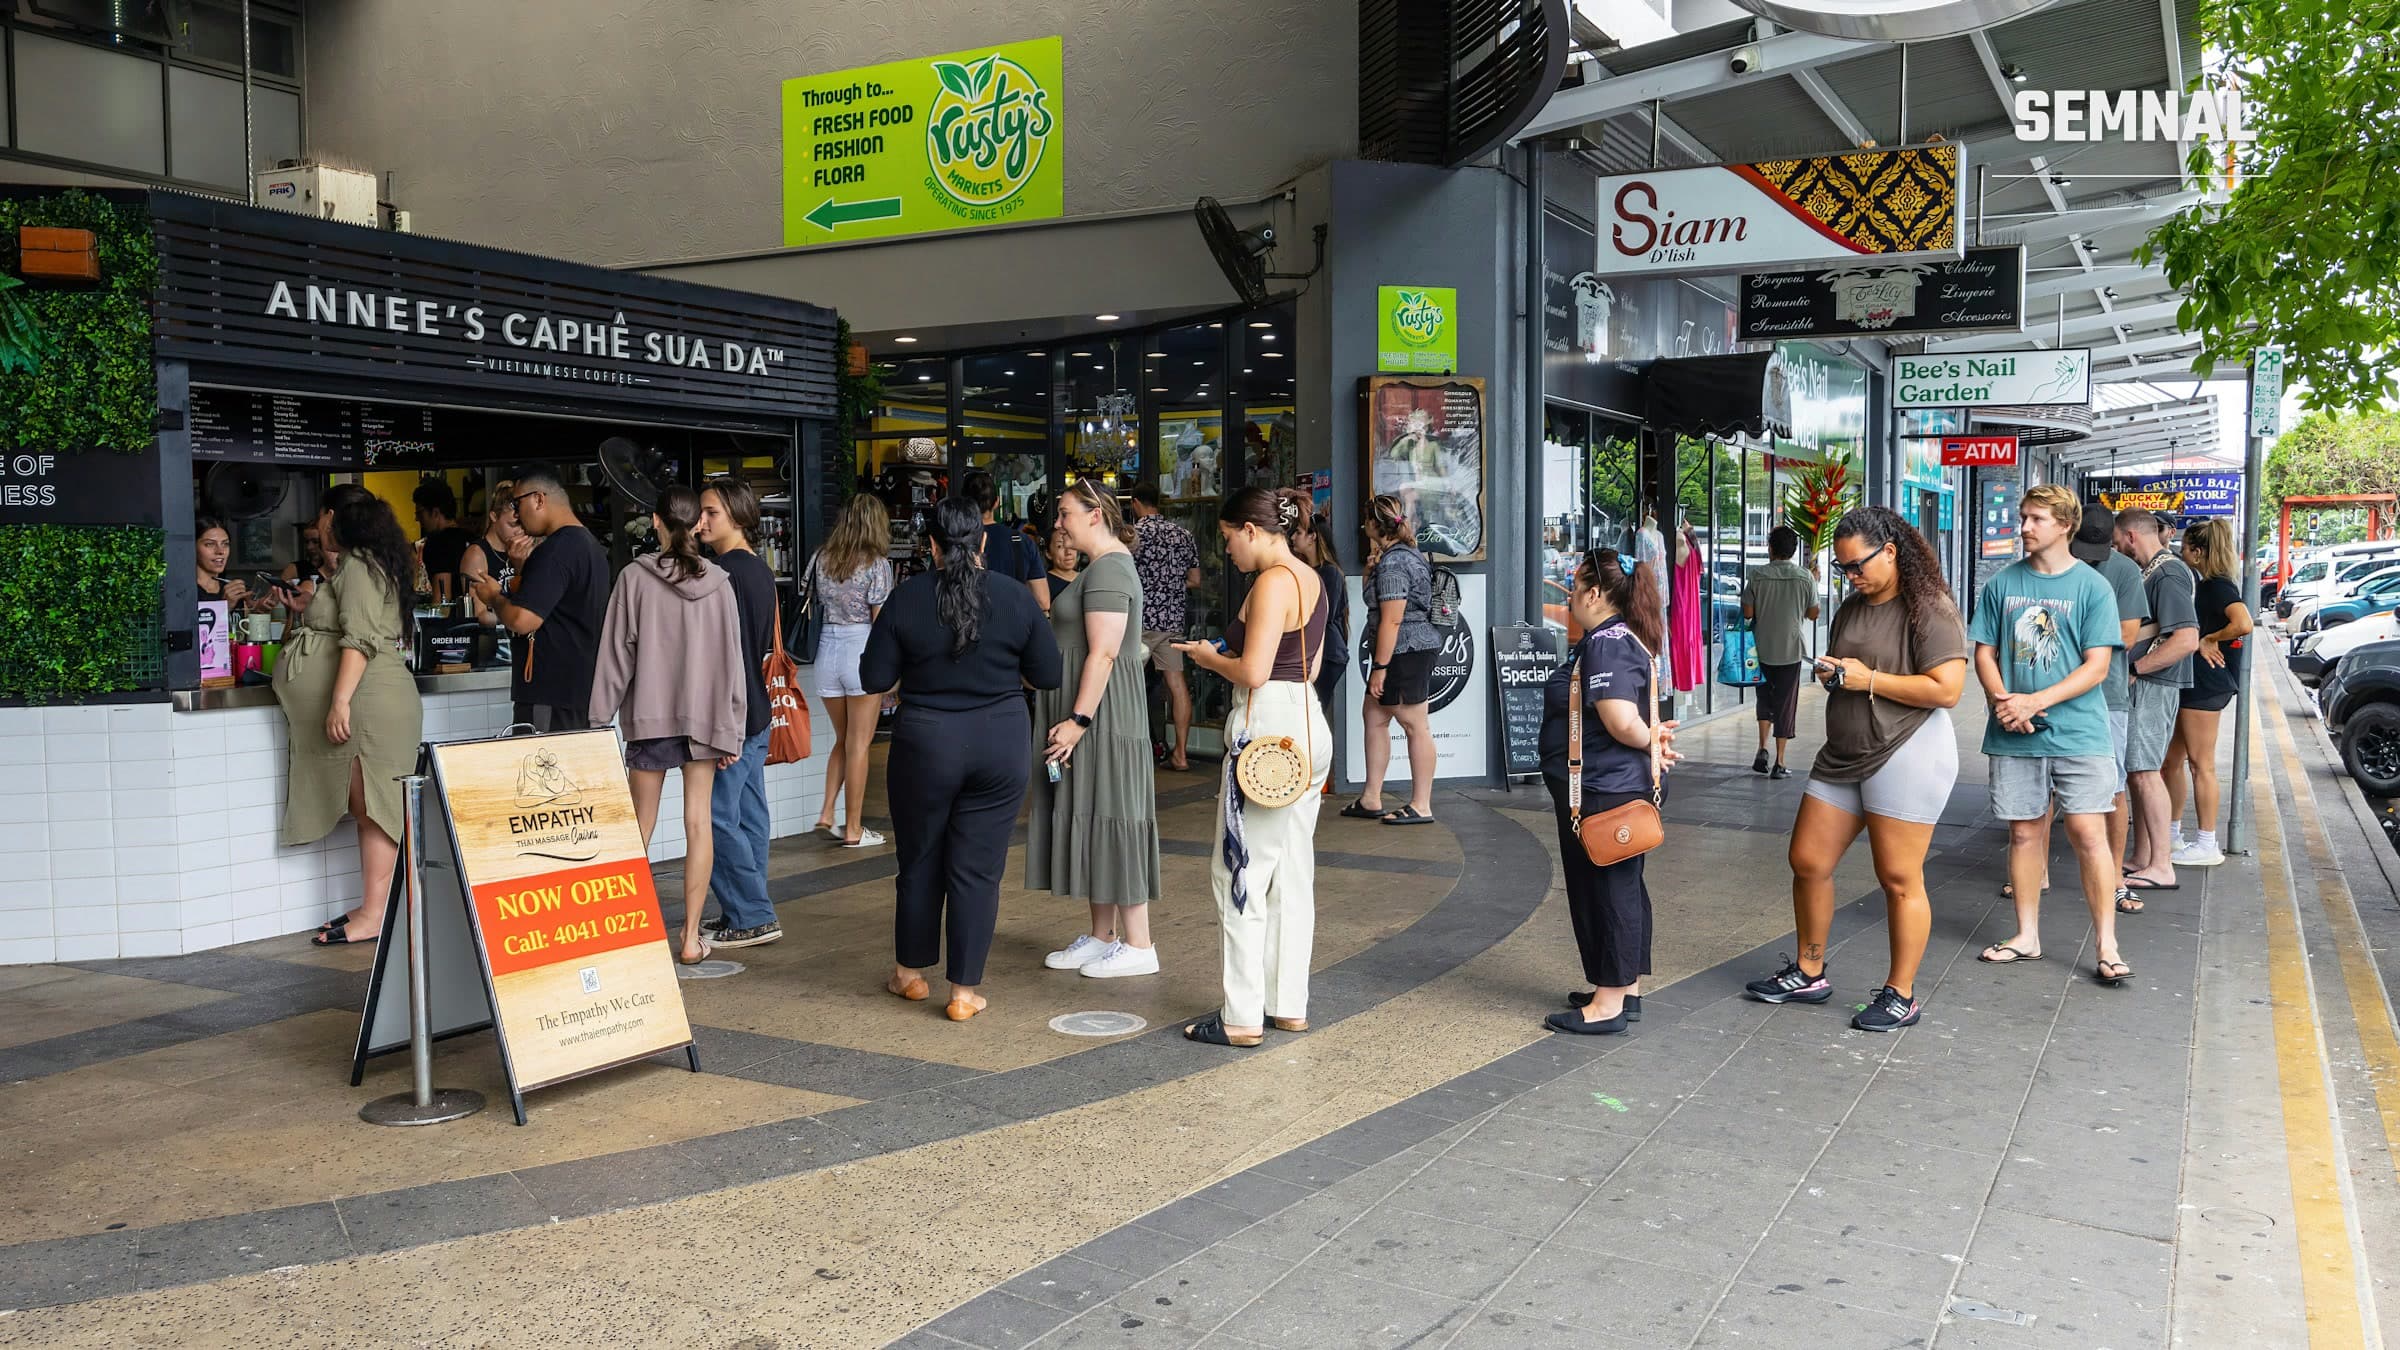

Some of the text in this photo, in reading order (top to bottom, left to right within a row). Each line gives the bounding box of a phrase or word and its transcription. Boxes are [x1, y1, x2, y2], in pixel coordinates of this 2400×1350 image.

[802, 82, 894, 107] Through to...
[813, 104, 914, 136] FRESH FOOD
[814, 135, 884, 161] FASHION
[814, 164, 865, 187] FLORA
[947, 169, 1003, 196] MARKETS
[269, 187, 290, 197] PAK
[924, 176, 1026, 220] OPERATING SINCE 1975
[1612, 181, 1748, 256] Siam
[1649, 247, 1696, 264] D'lish
[1942, 260, 1996, 278] Clothing
[1751, 272, 1805, 289] Gorgeous
[1750, 294, 1811, 309] Romantic
[1940, 283, 1996, 303] Lingerie
[264, 280, 485, 341] ANNEE'S
[502, 311, 631, 359] CAPHÊ
[643, 332, 711, 369] SUA
[1750, 316, 1814, 332] Irresistible
[1940, 307, 2012, 323] Accessories
[488, 358, 633, 385] VIETNAMESE COFFEE
[1900, 357, 2016, 380] Bee's Nail
[2257, 350, 2282, 372] 2P
[1808, 358, 1828, 400] Nail
[2257, 373, 2280, 382] TICKET
[1900, 382, 1990, 402] Garden
[1964, 442, 2011, 460] ATM
[13, 455, 55, 476] OF
[0, 484, 56, 506] ESS
[2143, 478, 2240, 492] CRYSTAL BALL
[2184, 490, 2228, 500] KSTORE
[2121, 494, 2162, 502] LUCKY
[431, 637, 454, 645] ORDER
[1432, 665, 1467, 676] SSERIE
[771, 675, 786, 689] All
[1571, 710, 1579, 742] MIMCO
[508, 806, 595, 835] EMPATHY
[515, 827, 599, 848] THAI MASSAGE Cairns
[496, 873, 638, 920] NOW OPEN
[503, 910, 649, 956] Call: 4041 0272
[536, 992, 656, 1031] The Empathy We Care
[558, 1016, 644, 1047] www.thaiempathy.com
